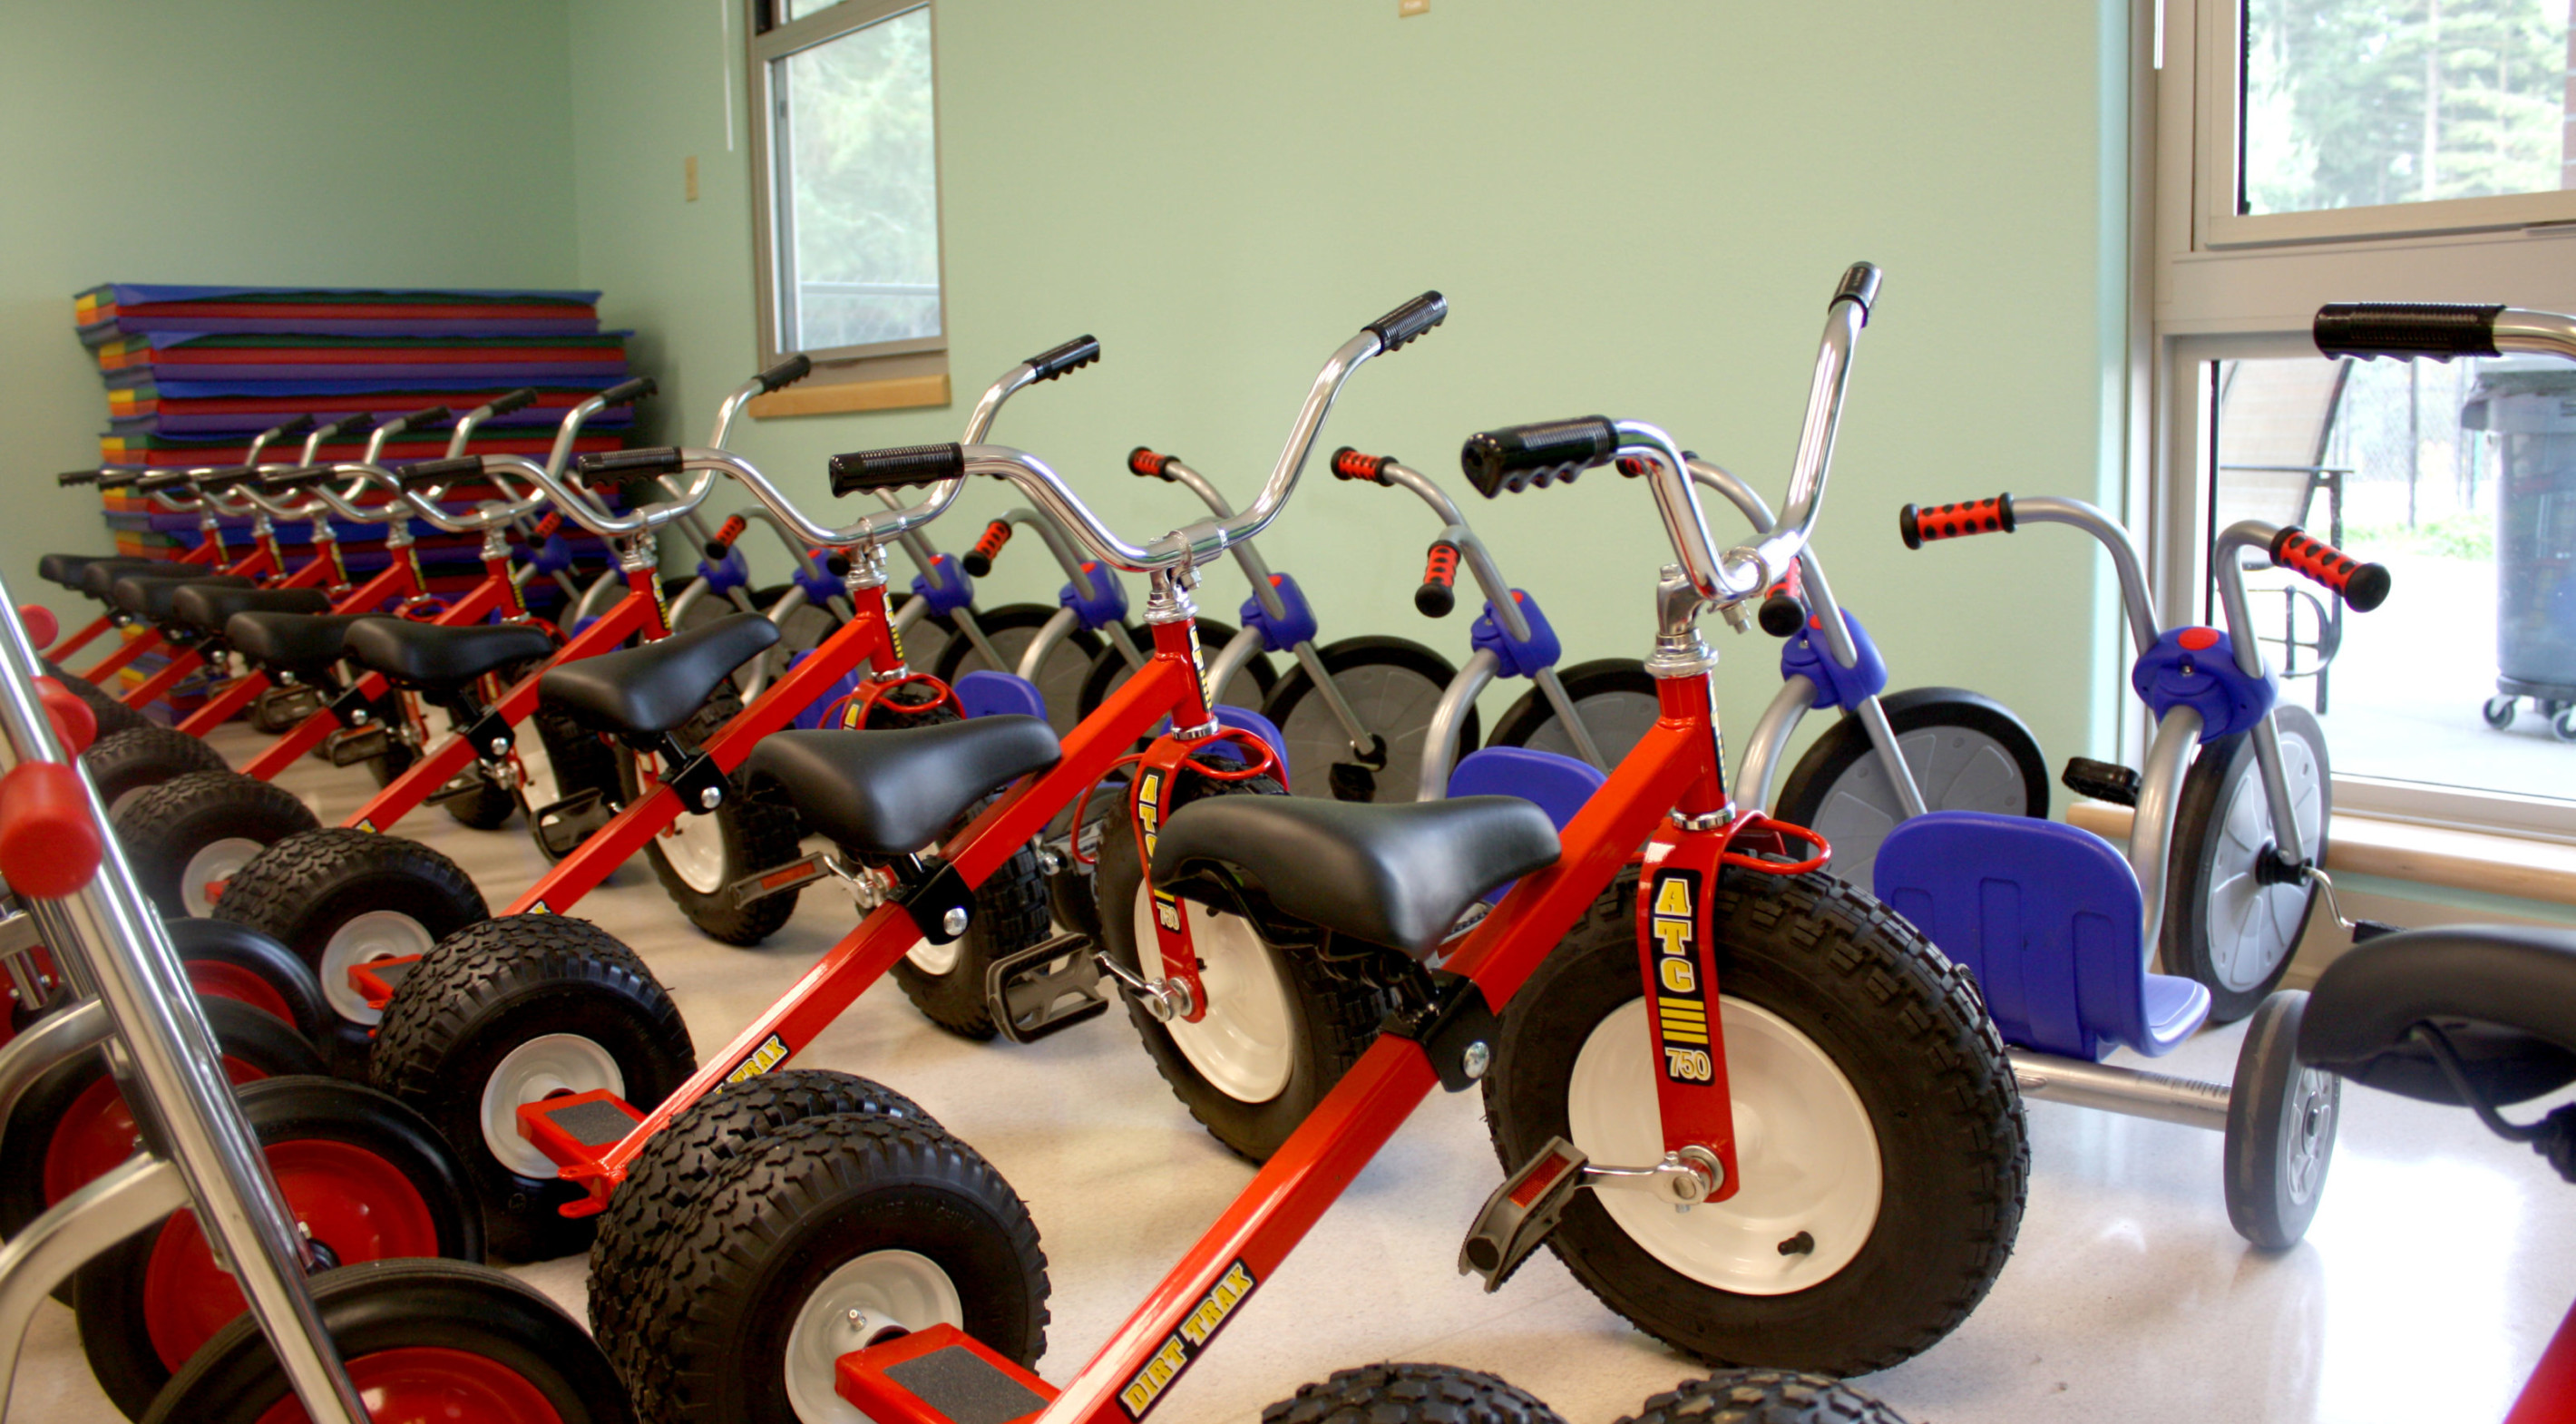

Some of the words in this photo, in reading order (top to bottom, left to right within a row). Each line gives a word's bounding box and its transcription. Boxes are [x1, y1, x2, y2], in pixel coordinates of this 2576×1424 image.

[1654, 877, 1696, 992] ATC
[1664, 1047, 1712, 1081] 750
[1119, 1334, 1188, 1419] DIRT
[1179, 1262, 1254, 1347] TRAX
